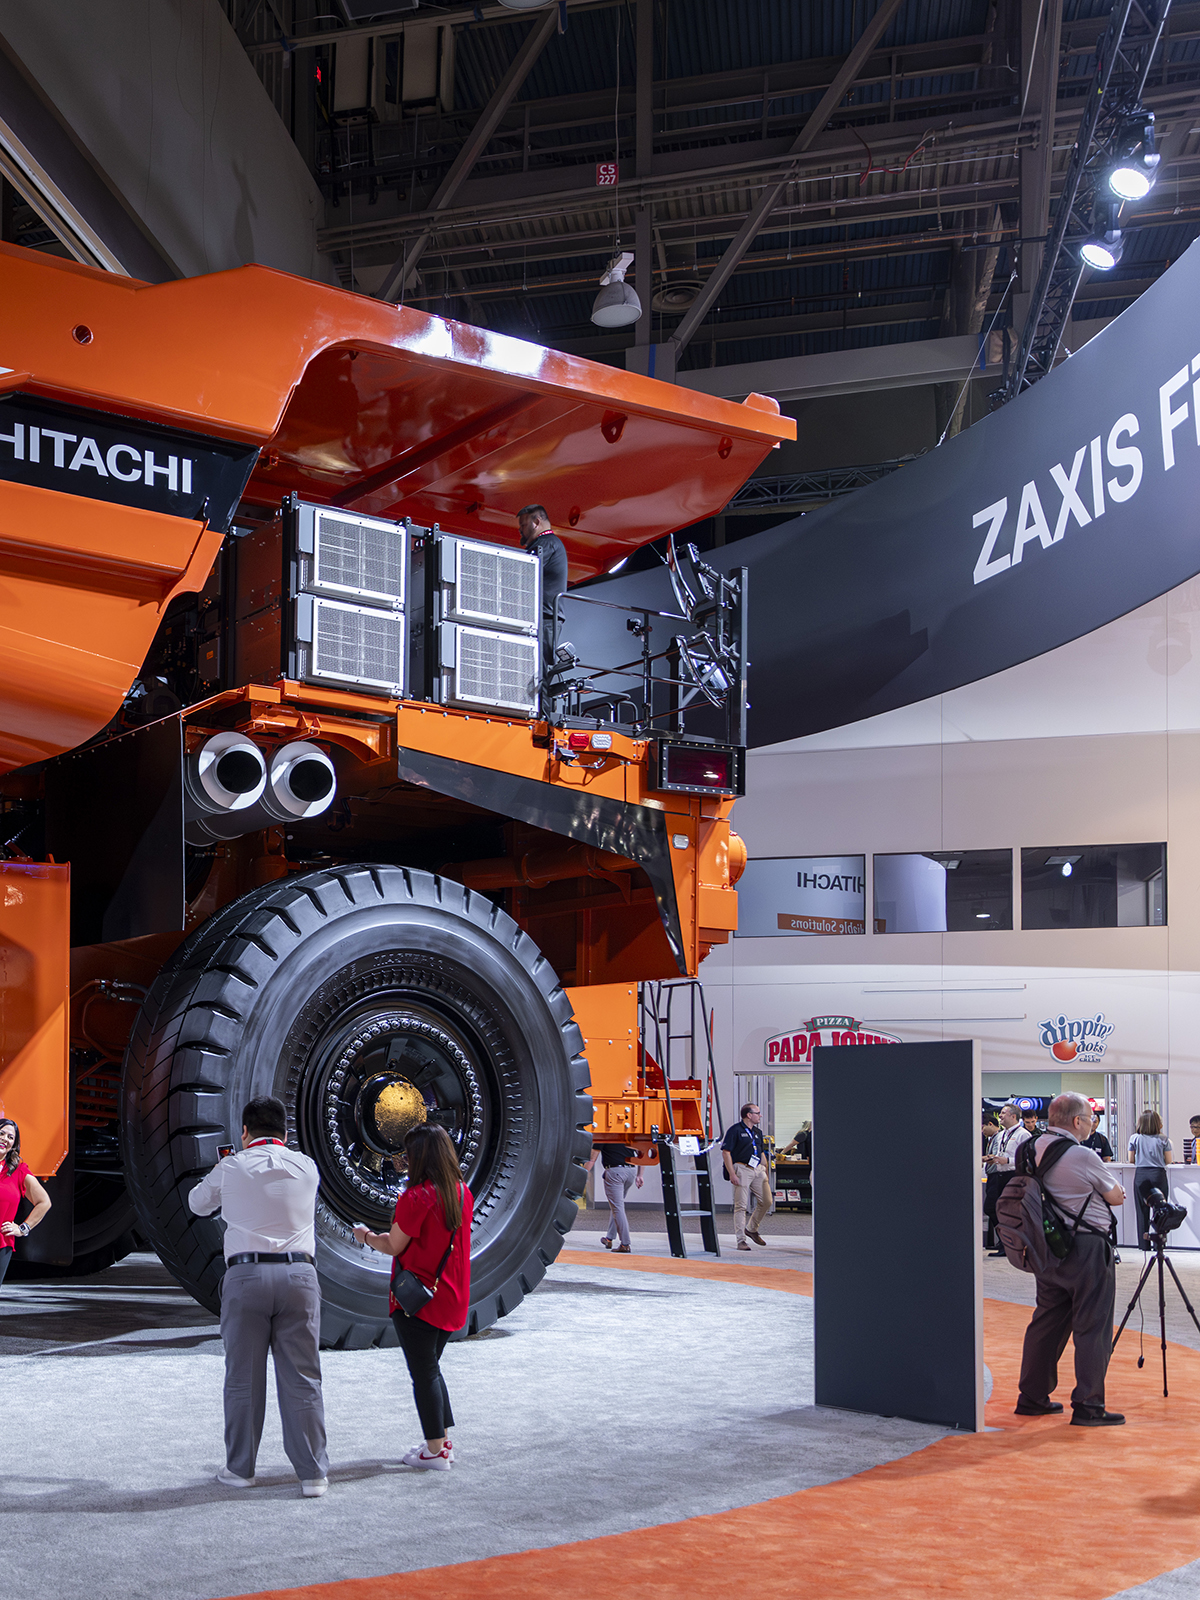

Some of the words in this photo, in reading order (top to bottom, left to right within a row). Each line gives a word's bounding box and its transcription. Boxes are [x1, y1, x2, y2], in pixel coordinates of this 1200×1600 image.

[600, 165, 615, 174] C5
[599, 175, 616, 185] 227
[972, 413, 1144, 585] ZAXIS
[816, 1018, 850, 1026] PIZZA
[768, 1032, 822, 1062] PAPA
